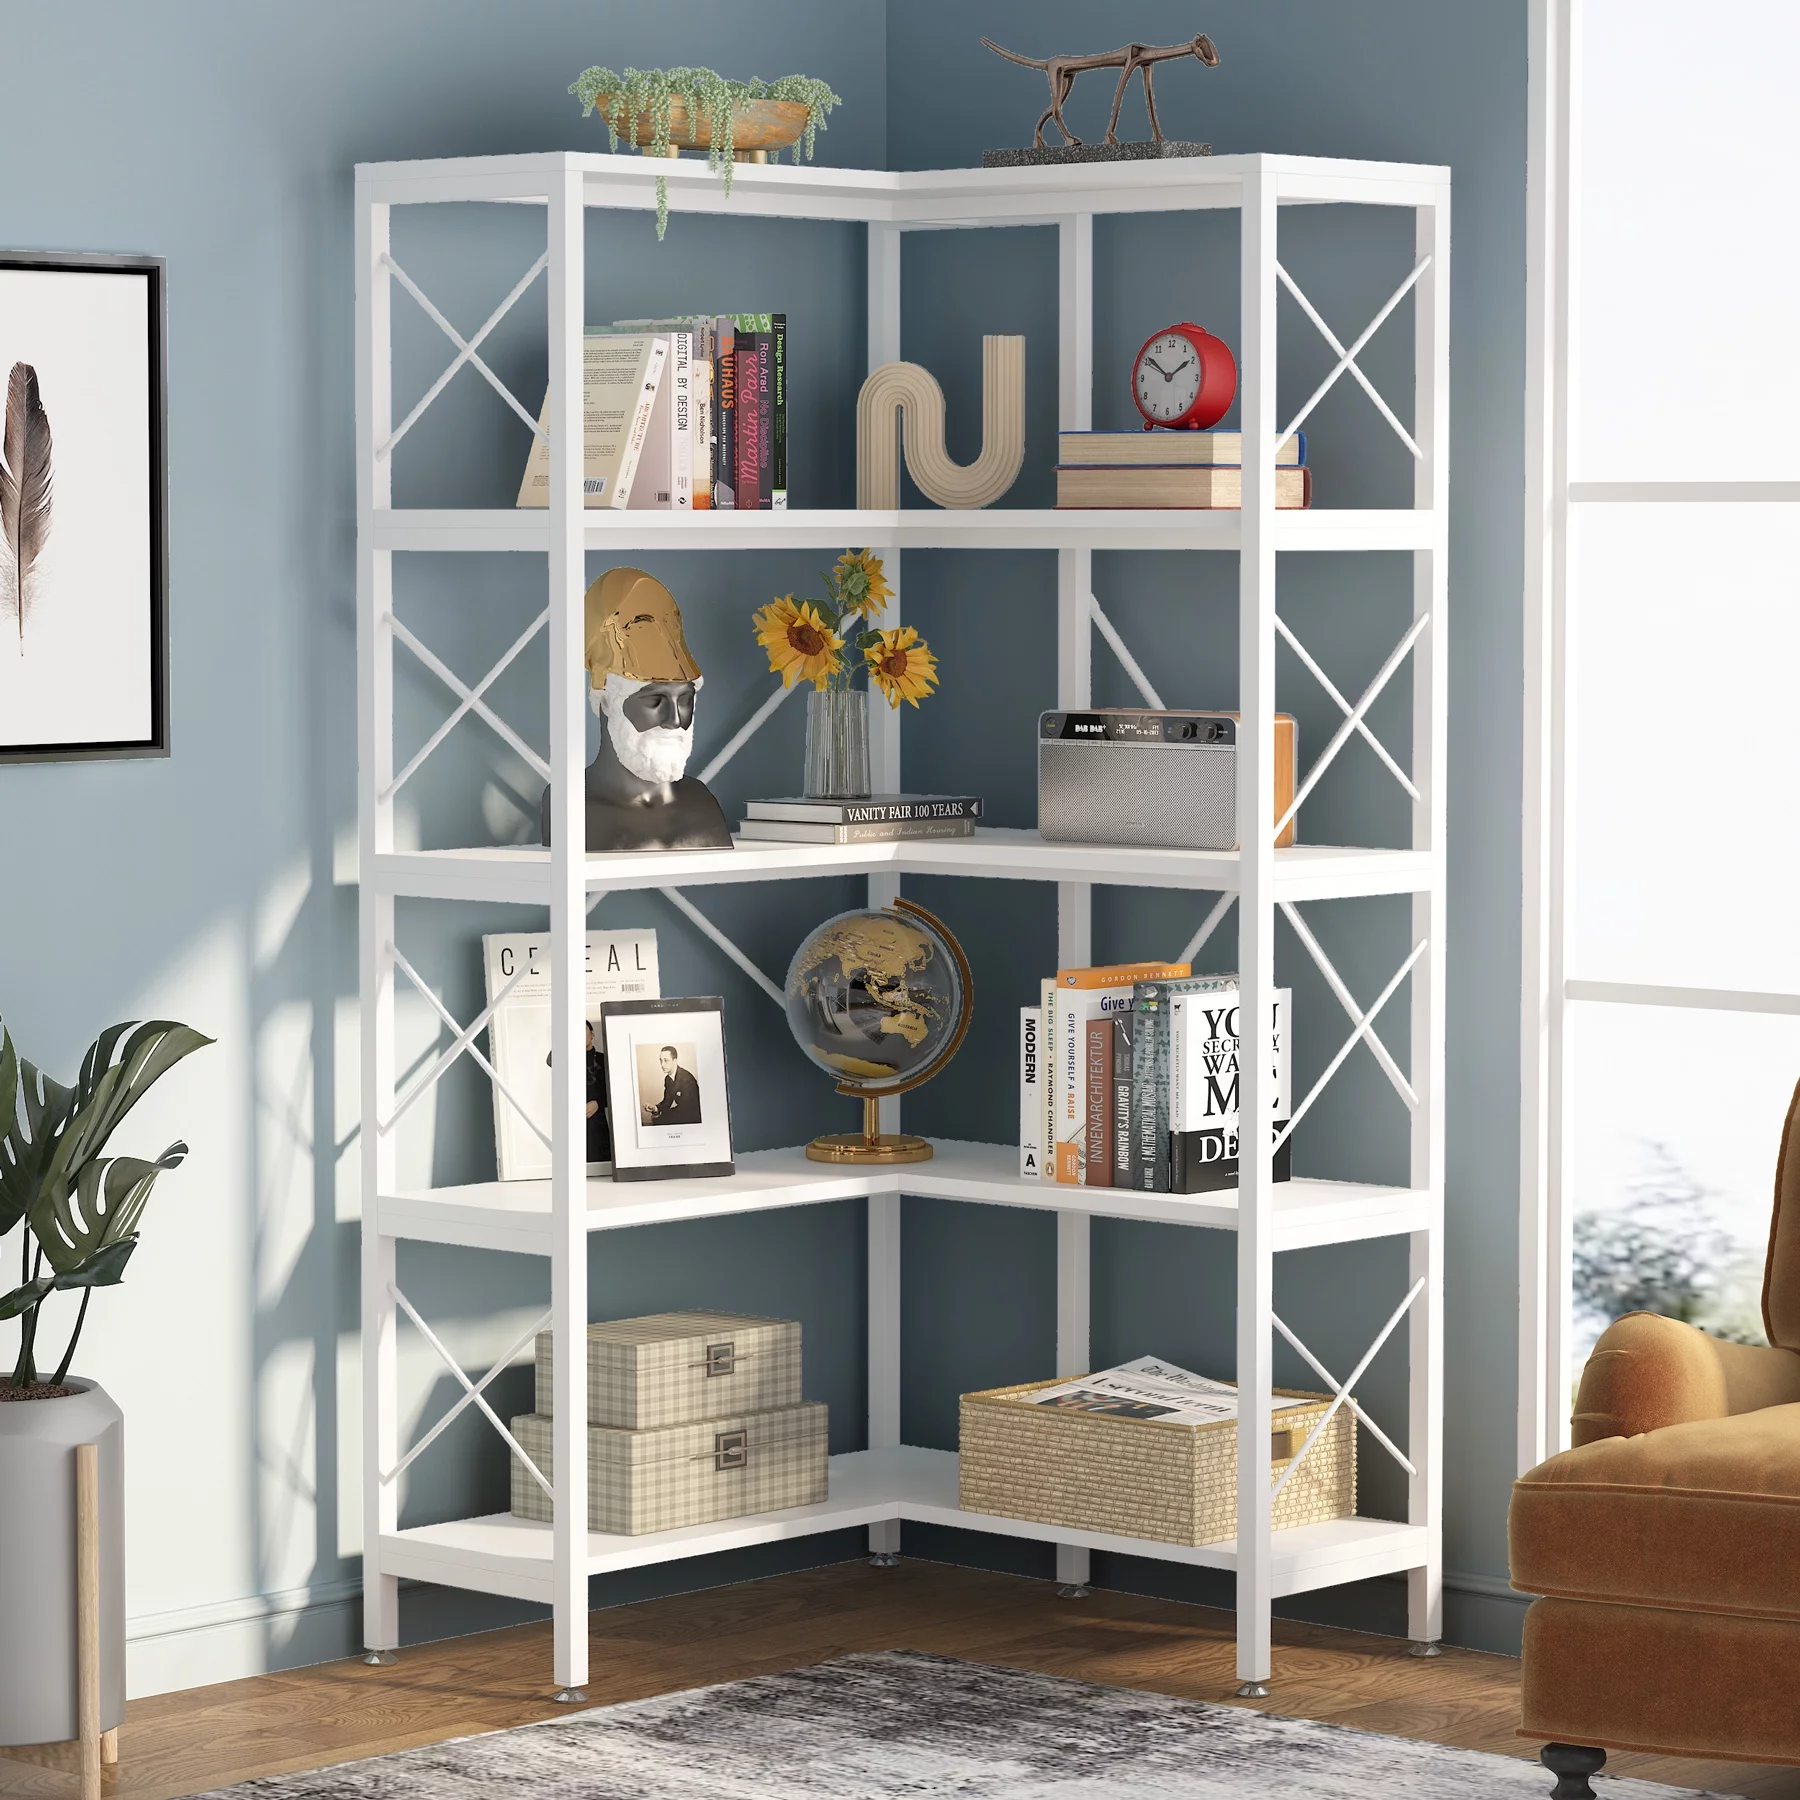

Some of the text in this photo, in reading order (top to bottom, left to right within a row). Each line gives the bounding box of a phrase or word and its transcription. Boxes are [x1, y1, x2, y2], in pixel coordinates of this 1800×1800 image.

[677, 333, 688, 372] DIGITAL
[760, 342, 768, 364] Ron
[775, 334, 784, 363] Design
[1155, 345, 1162, 354] 11
[1168, 340, 1176, 348] 12
[1183, 345, 1187, 353] 1
[1190, 356, 1195, 364] 2
[721, 336, 735, 409] BAUHAUS
[740, 354, 758, 404] Parr
[760, 366, 768, 392] Arad
[1195, 374, 1199, 382] 3
[677, 378, 688, 389] BY
[1144, 392, 1148, 400] 8
[677, 395, 688, 431] DESIGN
[1153, 404, 1157, 412] 7
[1165, 407, 1169, 415] 6
[1179, 402, 1182, 411] 5
[740, 409, 758, 480] Martin
[847, 802, 963, 821] VANITY FAIR 100 YEARS
[853, 829, 876, 838] Public
[880, 828, 894, 836] and
[897, 827, 923, 836] Indian
[926, 825, 956, 835] Housing
[501, 944, 646, 976] CEEAL
[1101, 970, 1184, 983] GORDON BENNETT
[1100, 996, 1125, 1011] Give
[1025, 1019, 1035, 1084] MODERN
[1090, 1031, 1103, 1163] INNENARCHITEKTUR
[1142, 1082, 1156, 1107] MOSAIC
[1118, 1085, 1129, 1171] GRAVITY'S RAINBOW
[1142, 1109, 1156, 1156] MATHEMATICAL
[1026, 1154, 1035, 1167] A
